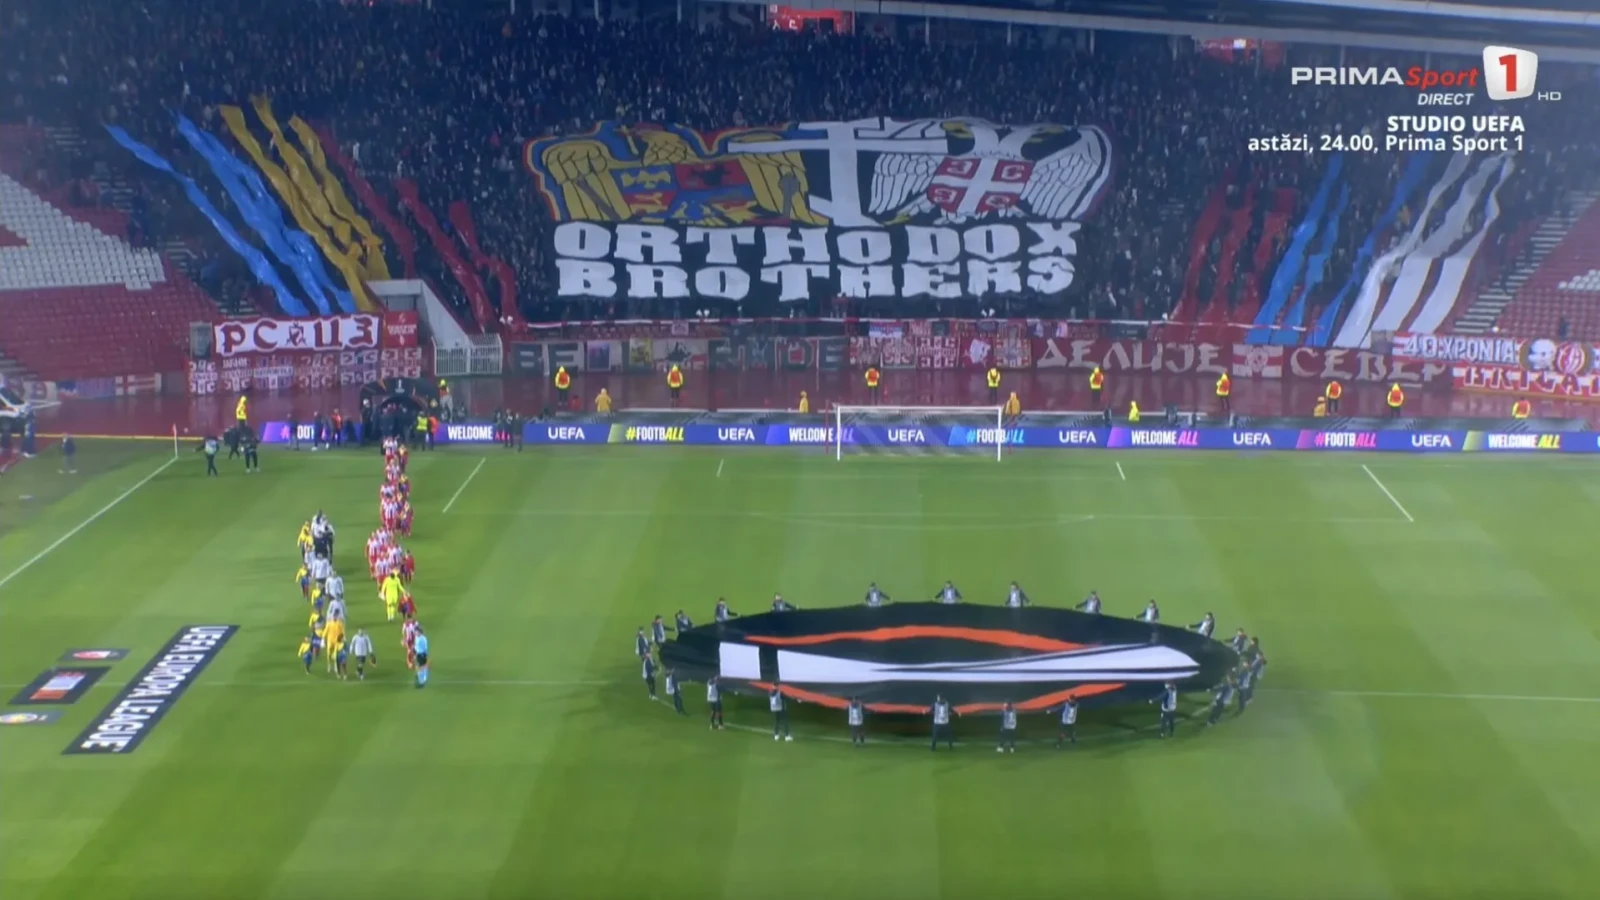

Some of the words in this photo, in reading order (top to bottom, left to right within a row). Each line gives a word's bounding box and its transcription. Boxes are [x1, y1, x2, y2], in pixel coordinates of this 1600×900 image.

[553, 221, 1080, 264] ORTHODOX
[555, 256, 1075, 301] BROTHERS
[448, 425, 493, 441] WELCOME
[548, 427, 585, 440] UEFA
[626, 427, 684, 441] #FOOTBALL
[718, 428, 755, 441] UEFA
[789, 427, 833, 442] WELCOME
[888, 429, 925, 442] UEFA
[1059, 431, 1096, 443] UEFA
[1131, 431, 1177, 445] WELCOME
[1177, 431, 1198, 445] ALL
[1233, 433, 1271, 445] UEFA
[1315, 432, 1377, 447] #FOOTBALL
[1412, 434, 1451, 447] UEFA
[1488, 434, 1538, 448] WELCOME
[1537, 434, 1561, 448] ALL
[170, 625, 229, 653] UEFA
[127, 653, 205, 698] EUROPA
[78, 699, 165, 752] LEAGUE
